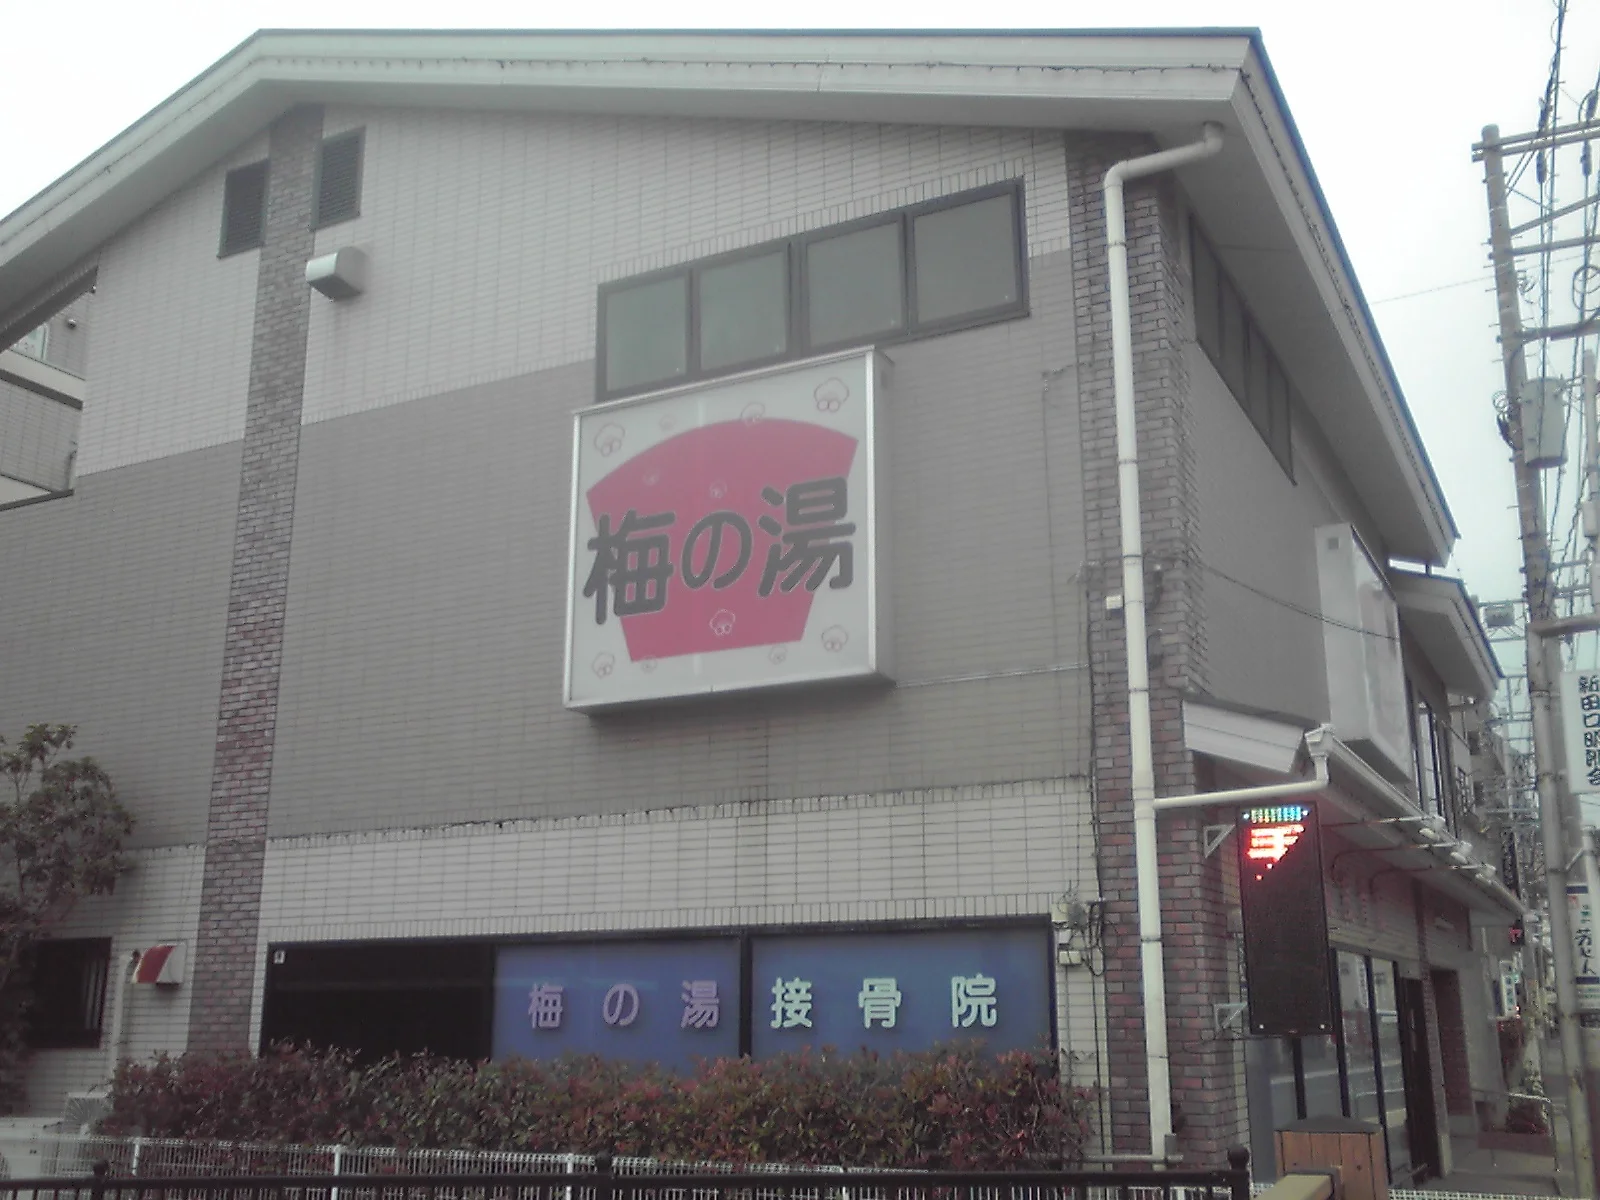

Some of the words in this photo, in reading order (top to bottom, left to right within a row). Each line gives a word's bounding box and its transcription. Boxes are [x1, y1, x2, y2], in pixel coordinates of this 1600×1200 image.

[583, 476, 856, 624] 梅の湯
[528, 979, 720, 1029] 梅の湯
[770, 974, 997, 1029] 接骨院
